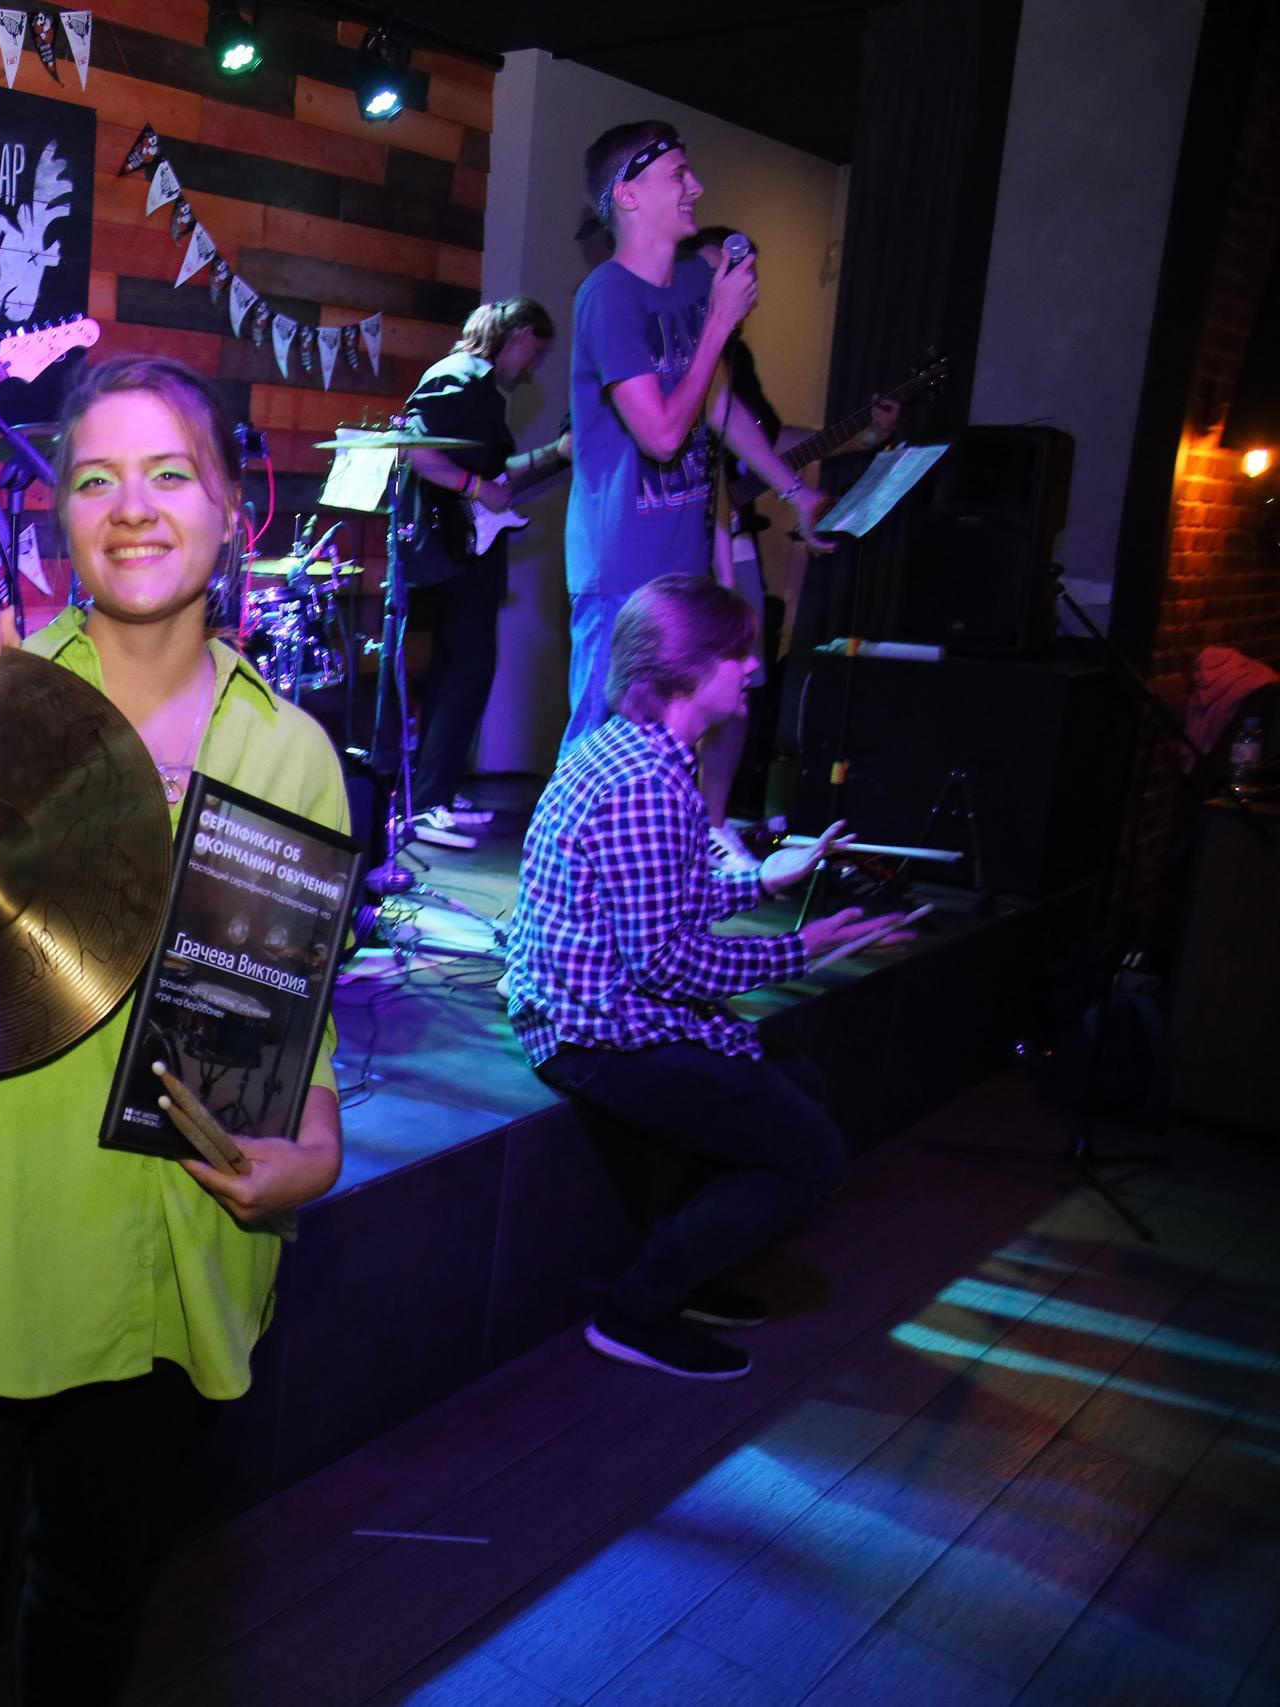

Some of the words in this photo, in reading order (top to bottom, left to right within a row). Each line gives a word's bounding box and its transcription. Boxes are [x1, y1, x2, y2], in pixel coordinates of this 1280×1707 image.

[199, 809, 283, 856] СЕРТИФИКАТ
[283, 844, 302, 862] ОБ
[187, 858, 230, 882] Настоящий
[193, 832, 276, 875] ОКОНЧАНИИ
[276, 864, 339, 899] ОБУЧЕНИЯ
[173, 932, 236, 970] Грачева
[236, 953, 308, 993] Виктория
